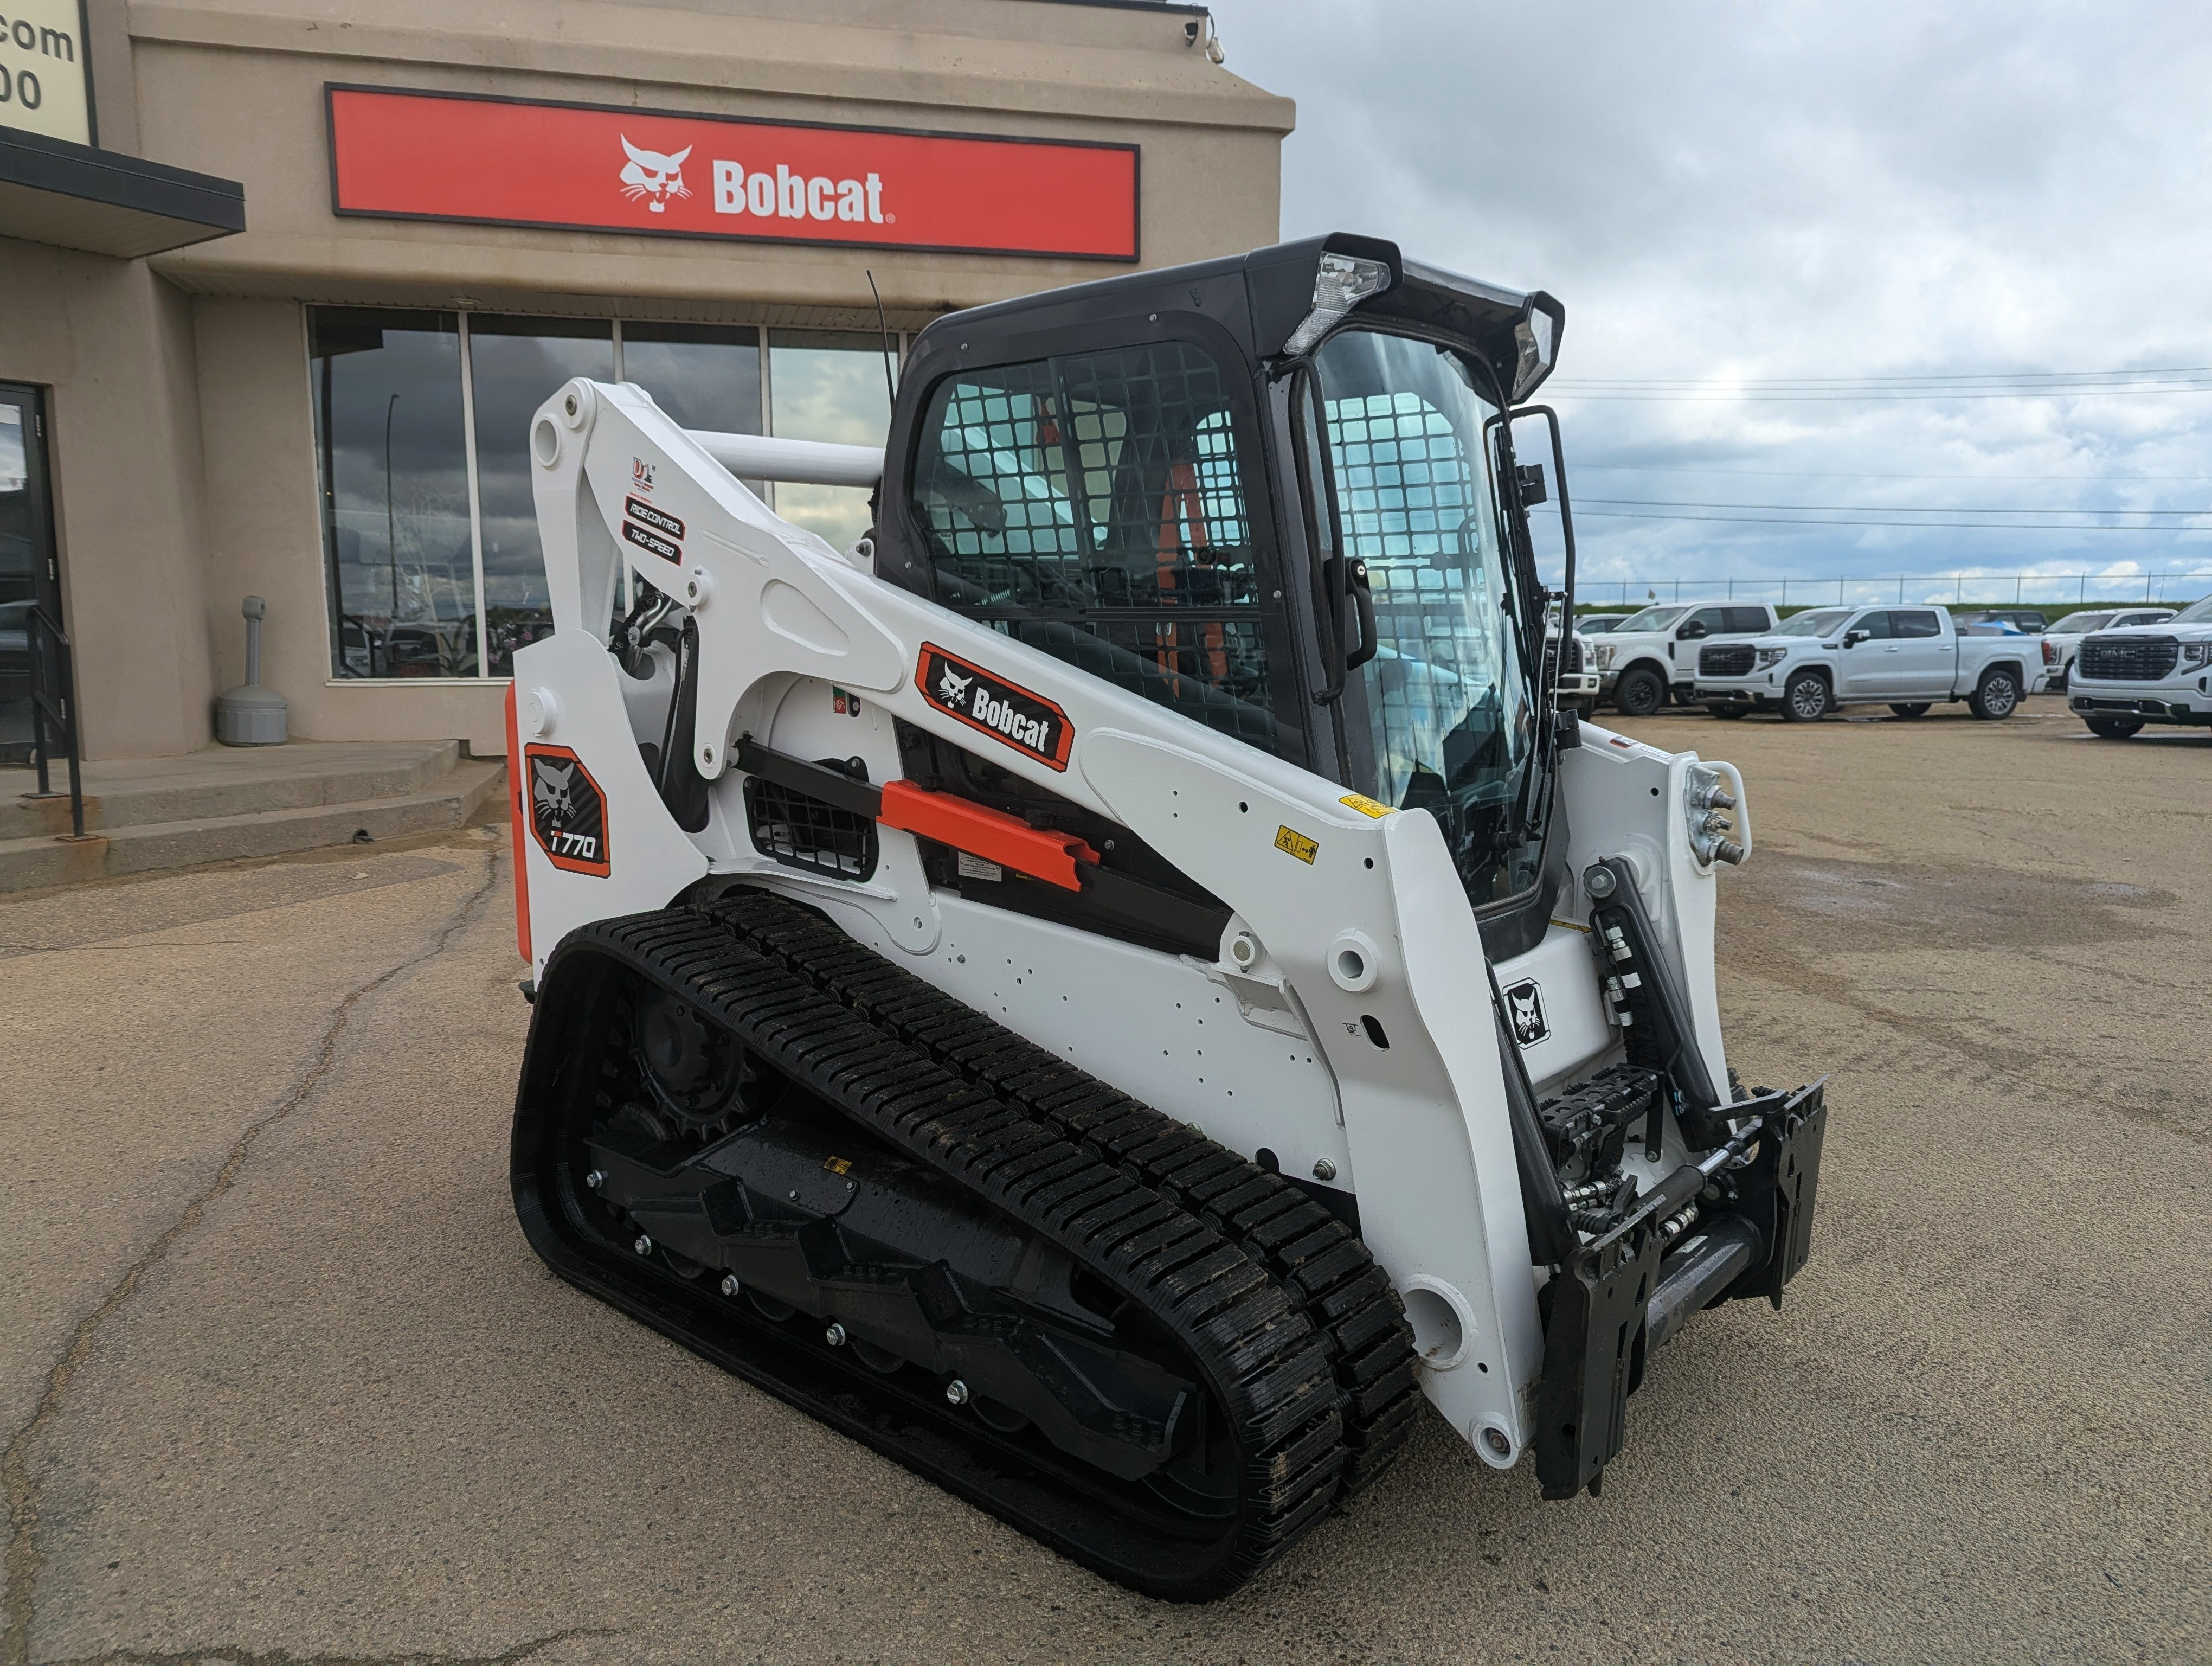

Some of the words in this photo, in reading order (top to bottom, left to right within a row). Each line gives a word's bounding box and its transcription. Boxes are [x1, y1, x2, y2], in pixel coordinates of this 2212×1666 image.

[712, 159, 884, 224] Bobcat
[630, 503, 649, 518] RIDE
[646, 511, 681, 535] CONTROL
[631, 529, 675, 557] TWO-SPEED
[972, 687, 1049, 752] Bobcat
[551, 830, 596, 858] T770
